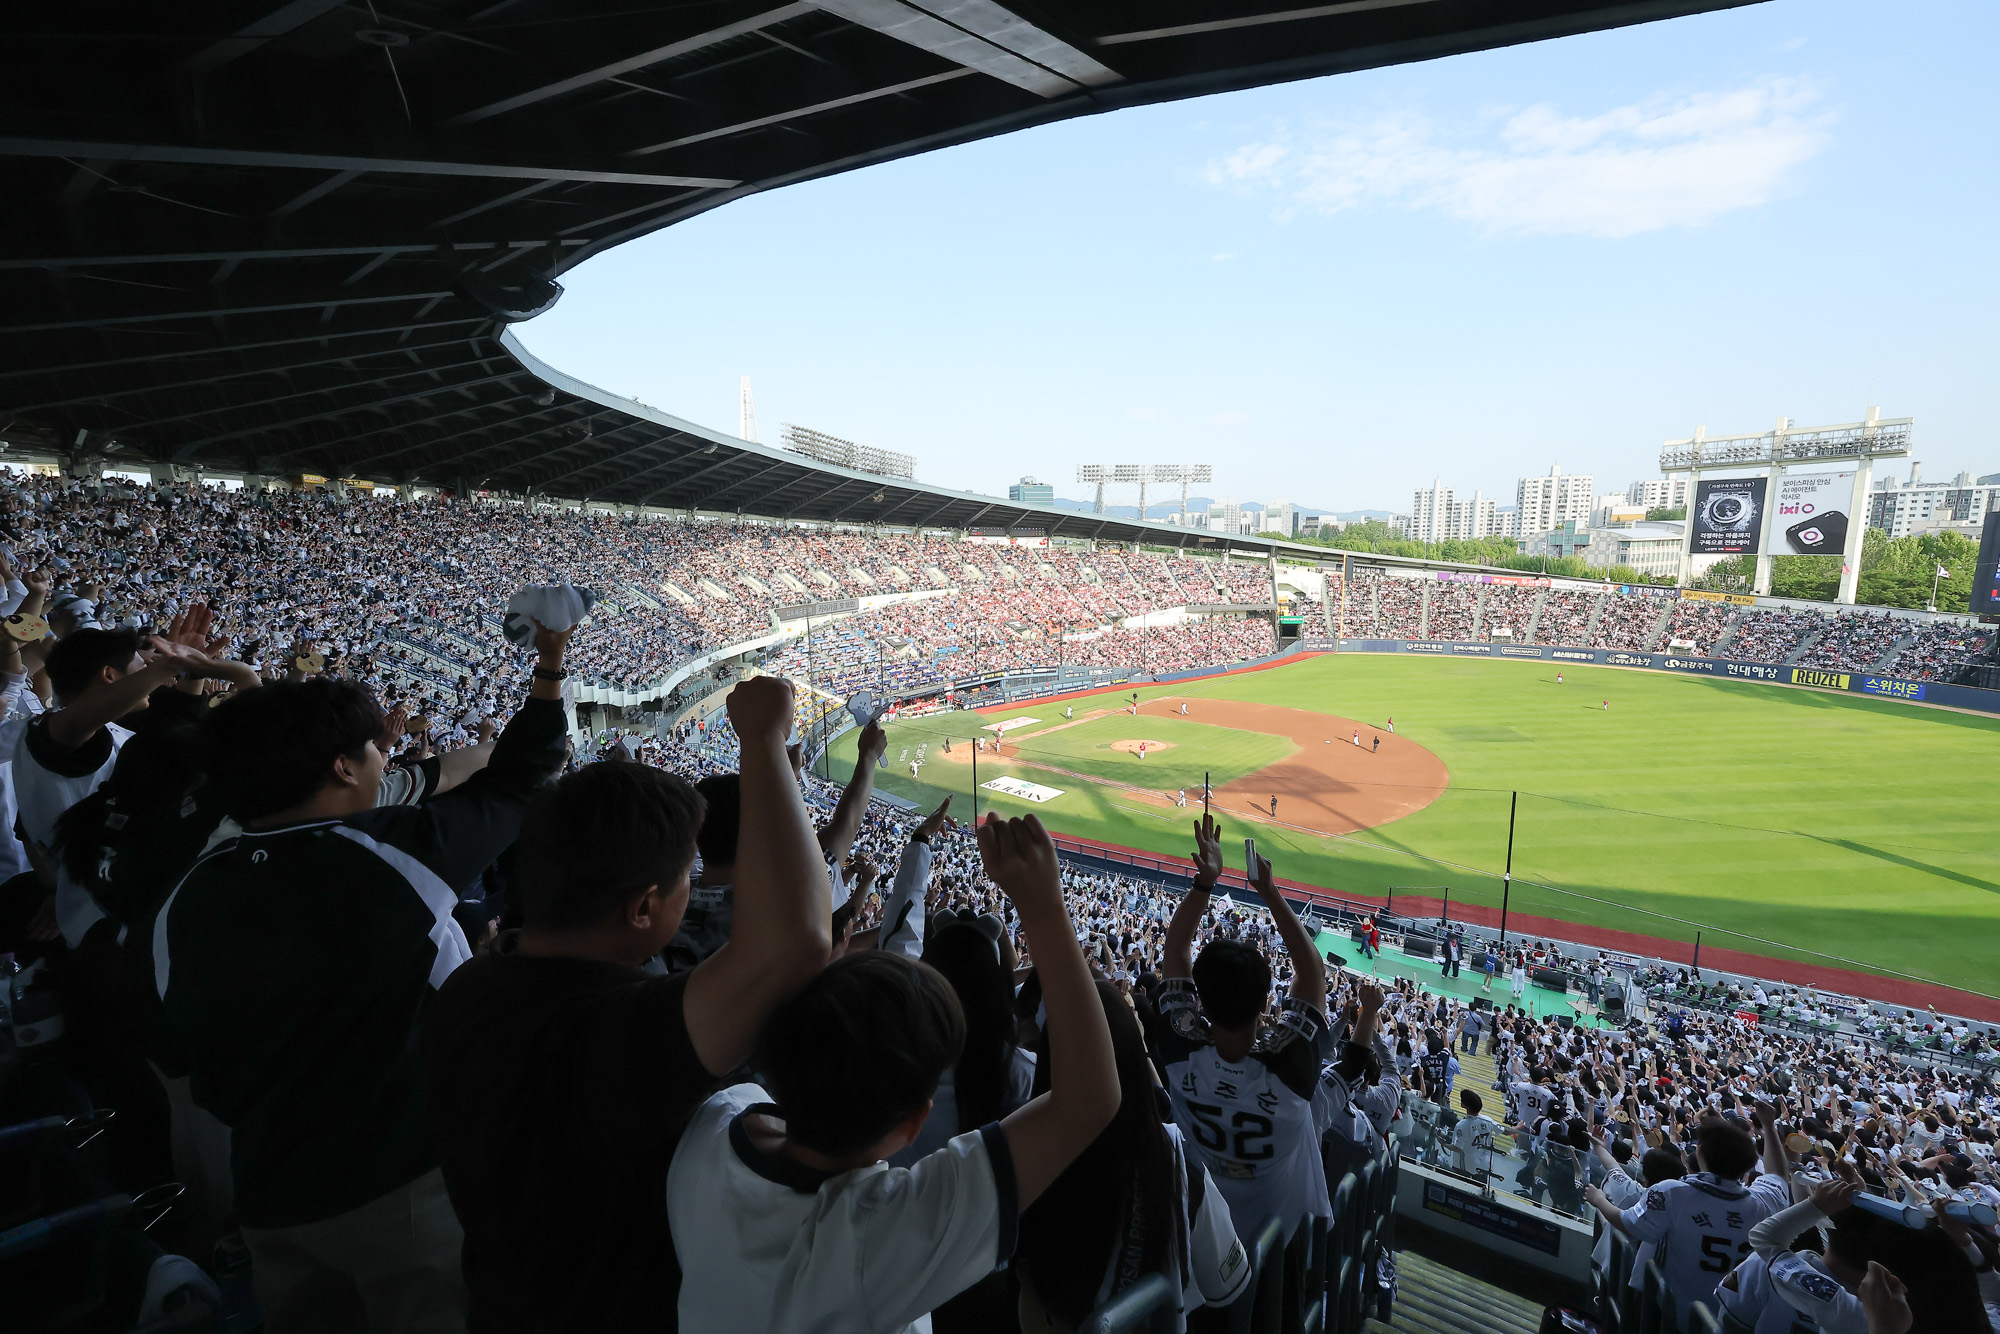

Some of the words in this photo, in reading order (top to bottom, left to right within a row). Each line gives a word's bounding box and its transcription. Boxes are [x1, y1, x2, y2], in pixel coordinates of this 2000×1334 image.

[1782, 479, 1815, 487] 보이스피싱
[1816, 478, 1831, 486] 안심
[1521, 578, 1550, 587] 두산밥캣
[1680, 660, 1713, 671] 금강주택
[1726, 663, 1779, 679] 현대해상
[1796, 669, 1843, 688] REUZEL
[1866, 678, 1920, 695] 스위치온
[1527, 1095, 1541, 1108] 31
[1185, 1098, 1274, 1160] 52
[1471, 1132, 1490, 1147] 47
[1725, 1211, 1744, 1229] 준
